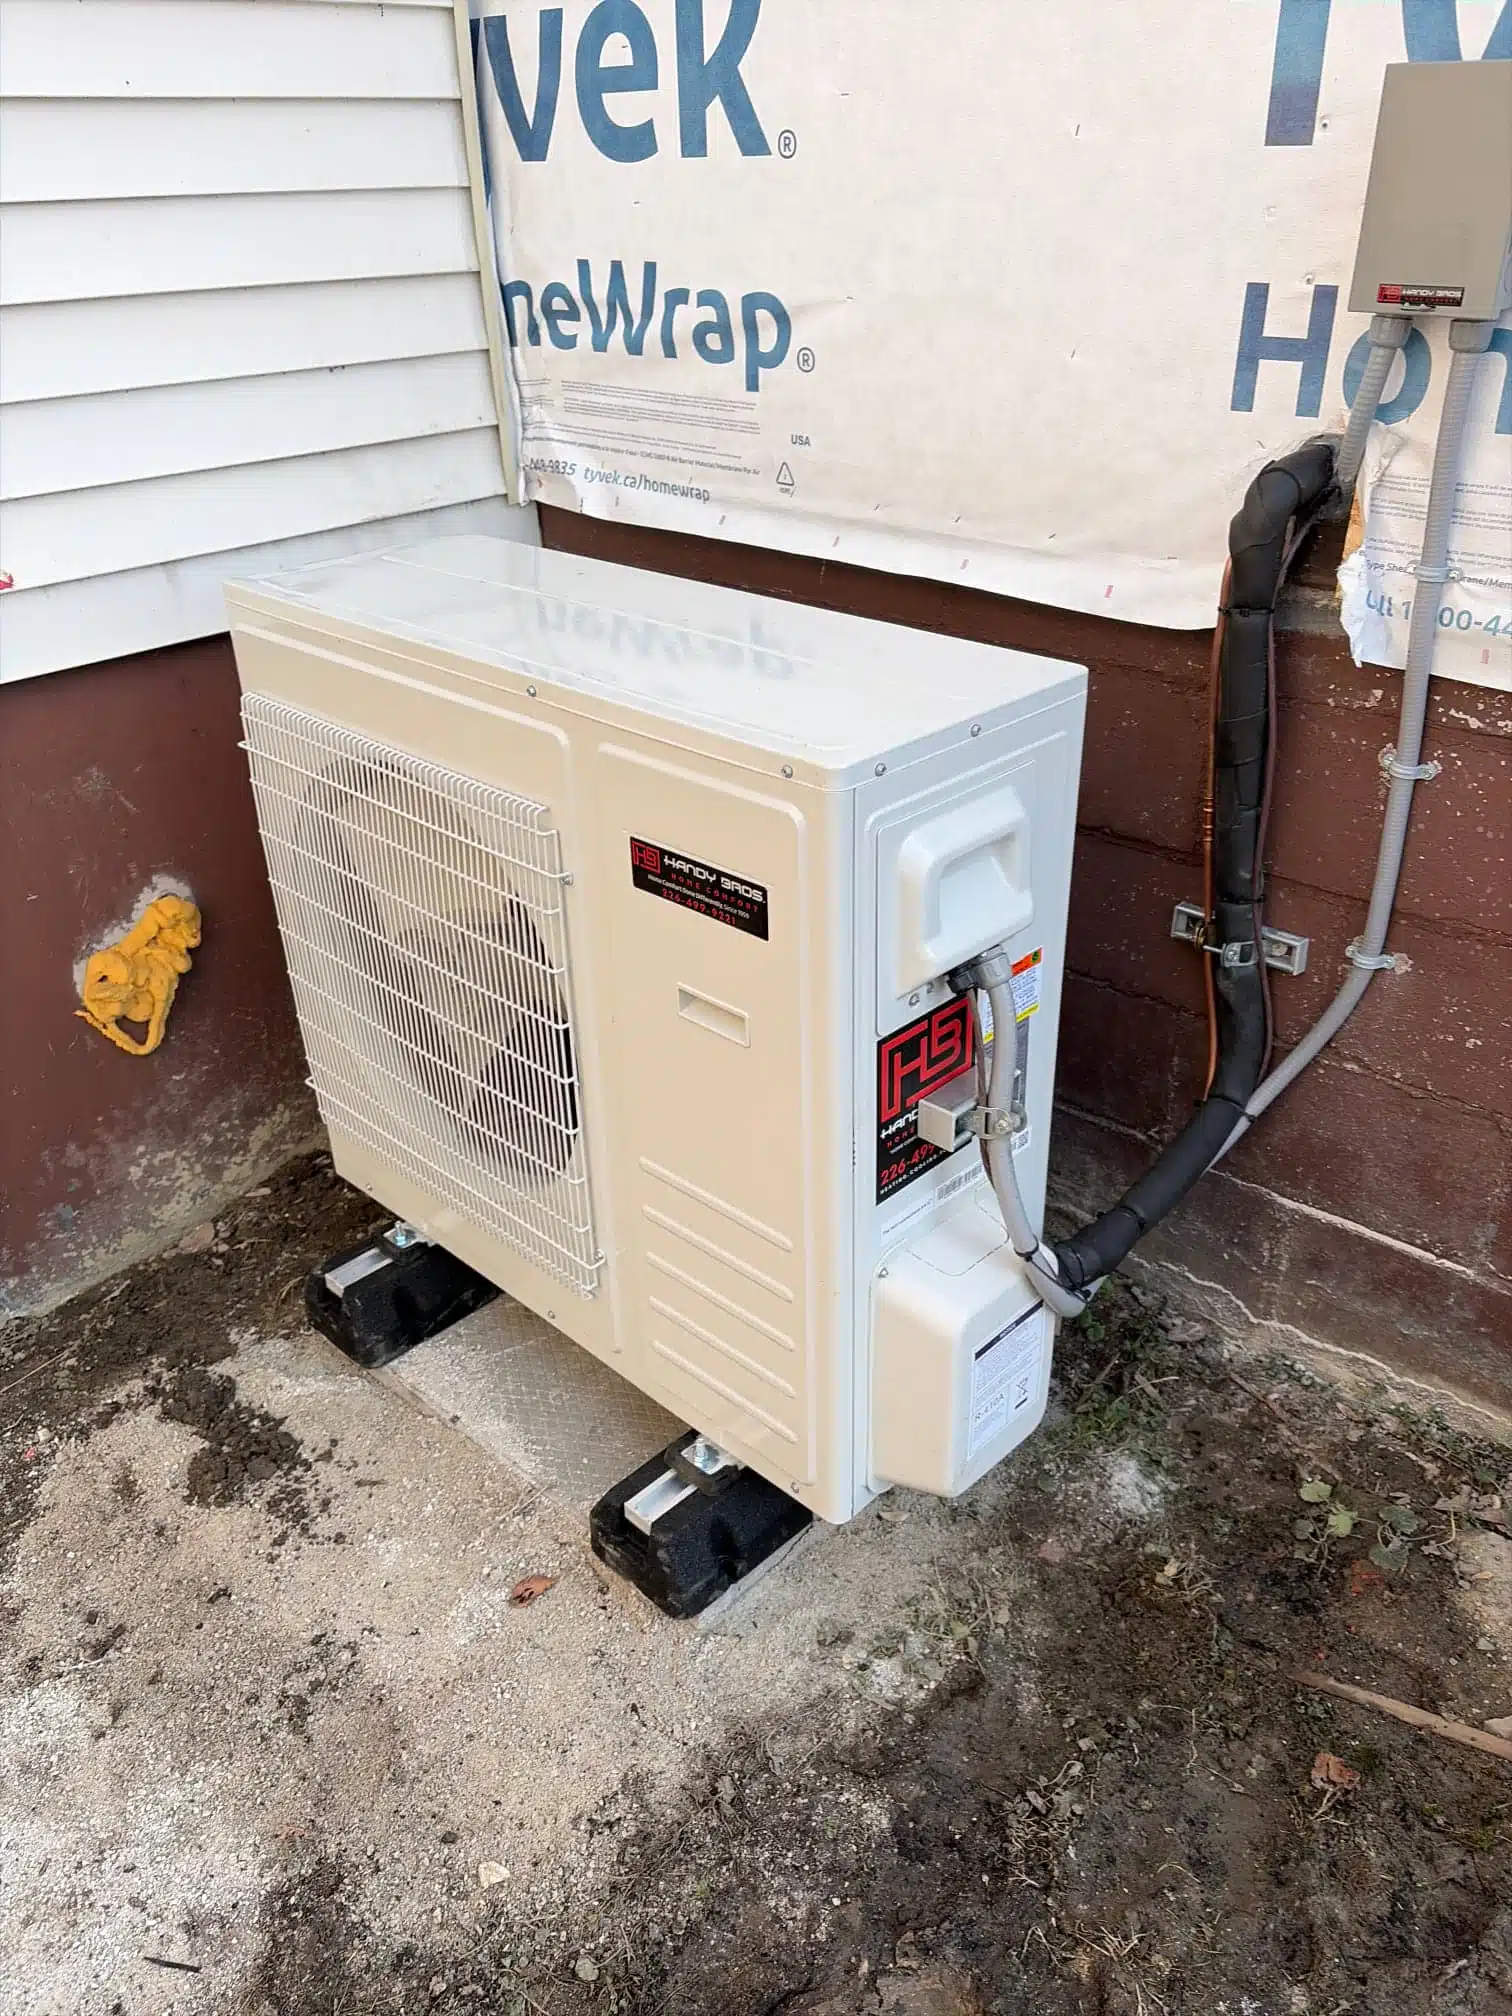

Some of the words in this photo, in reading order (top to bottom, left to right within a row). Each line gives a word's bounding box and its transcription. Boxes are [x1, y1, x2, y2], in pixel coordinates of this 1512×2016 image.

[791, 434, 811, 446] USA
[584, 466, 710, 504] tyvek.ca/homewrap
[664, 855, 717, 883] HANDY
[671, 872, 700, 890] HOME
[706, 887, 758, 913] COMFORT
